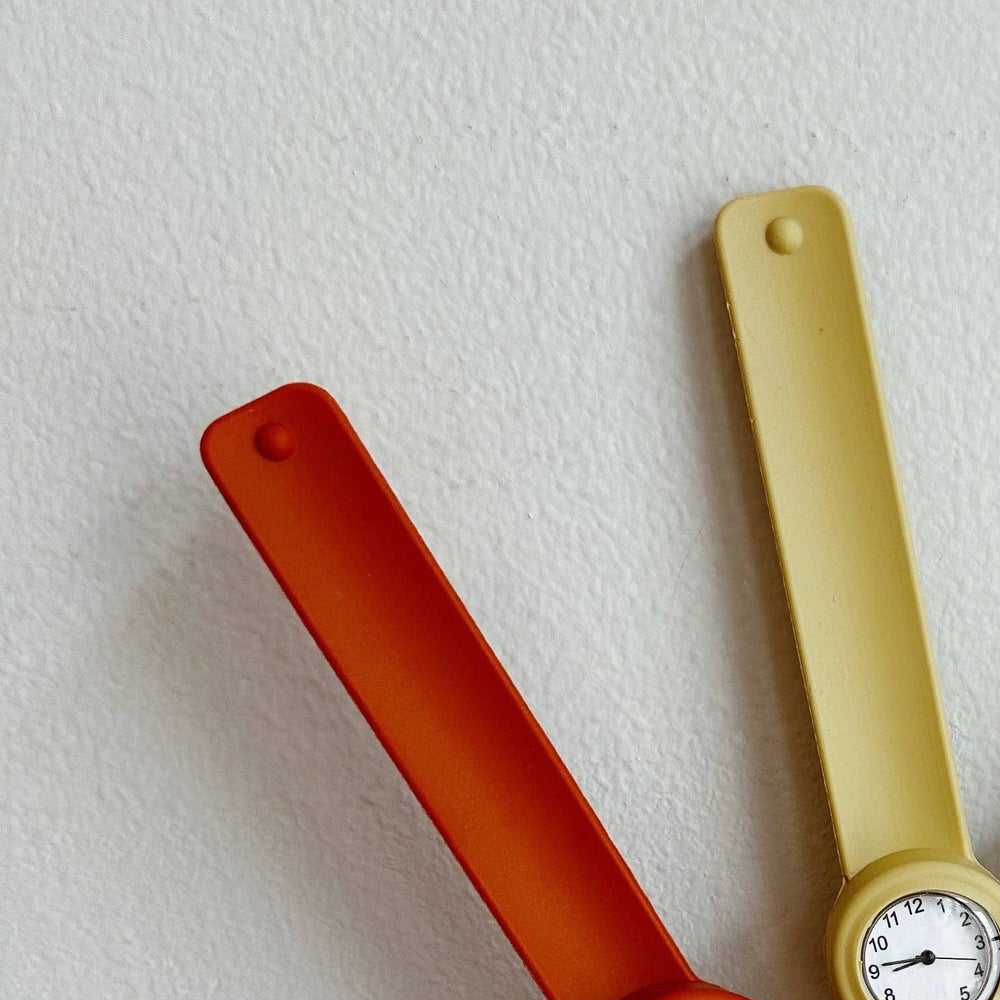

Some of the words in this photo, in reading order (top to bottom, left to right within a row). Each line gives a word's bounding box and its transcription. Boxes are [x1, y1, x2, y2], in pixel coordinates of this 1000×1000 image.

[904, 898, 924, 915] 12
[937, 899, 945, 913] 1
[883, 911, 899, 928] 11
[960, 912, 971, 926] 2
[869, 936, 888, 952] 10
[974, 935, 985, 950] 3
[868, 964, 880, 979] 9
[974, 963, 984, 977] 4
[960, 986, 970, 1000] 5
